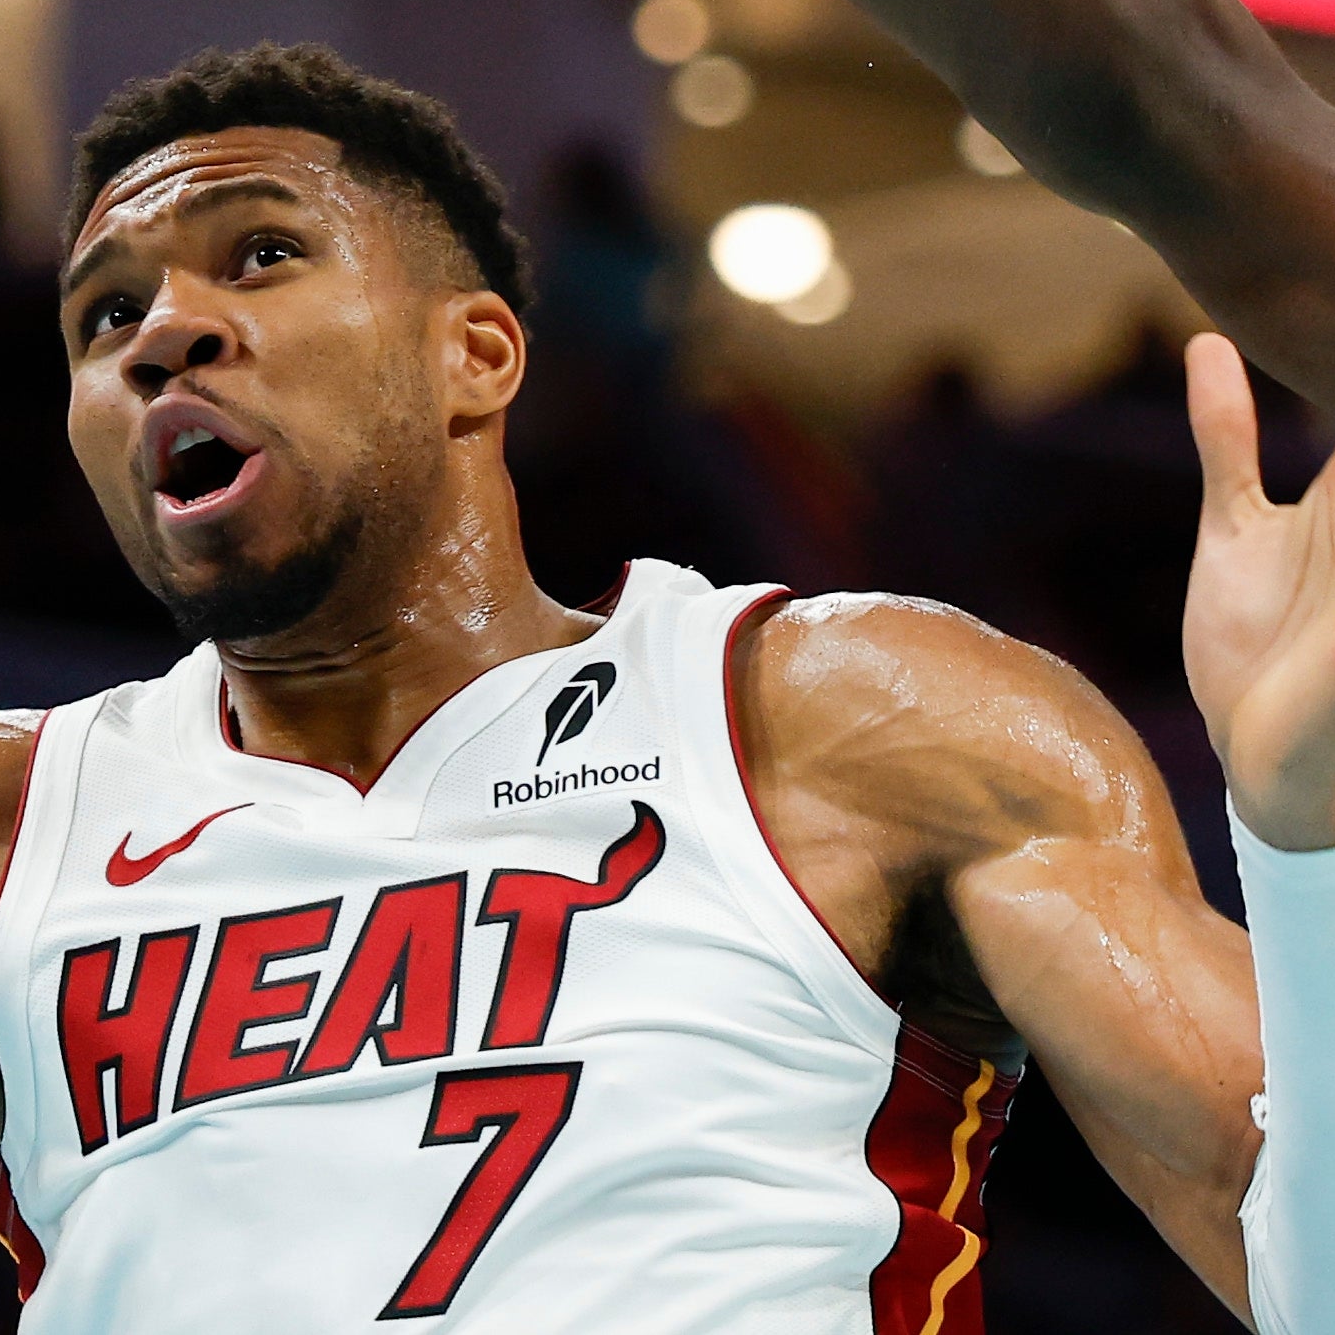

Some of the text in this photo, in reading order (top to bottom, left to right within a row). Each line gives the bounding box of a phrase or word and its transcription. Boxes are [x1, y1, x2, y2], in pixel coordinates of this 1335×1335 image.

[493, 755, 661, 809] Robinhood
[56, 799, 667, 1157] HEAT
[375, 1060, 585, 1322] 7
